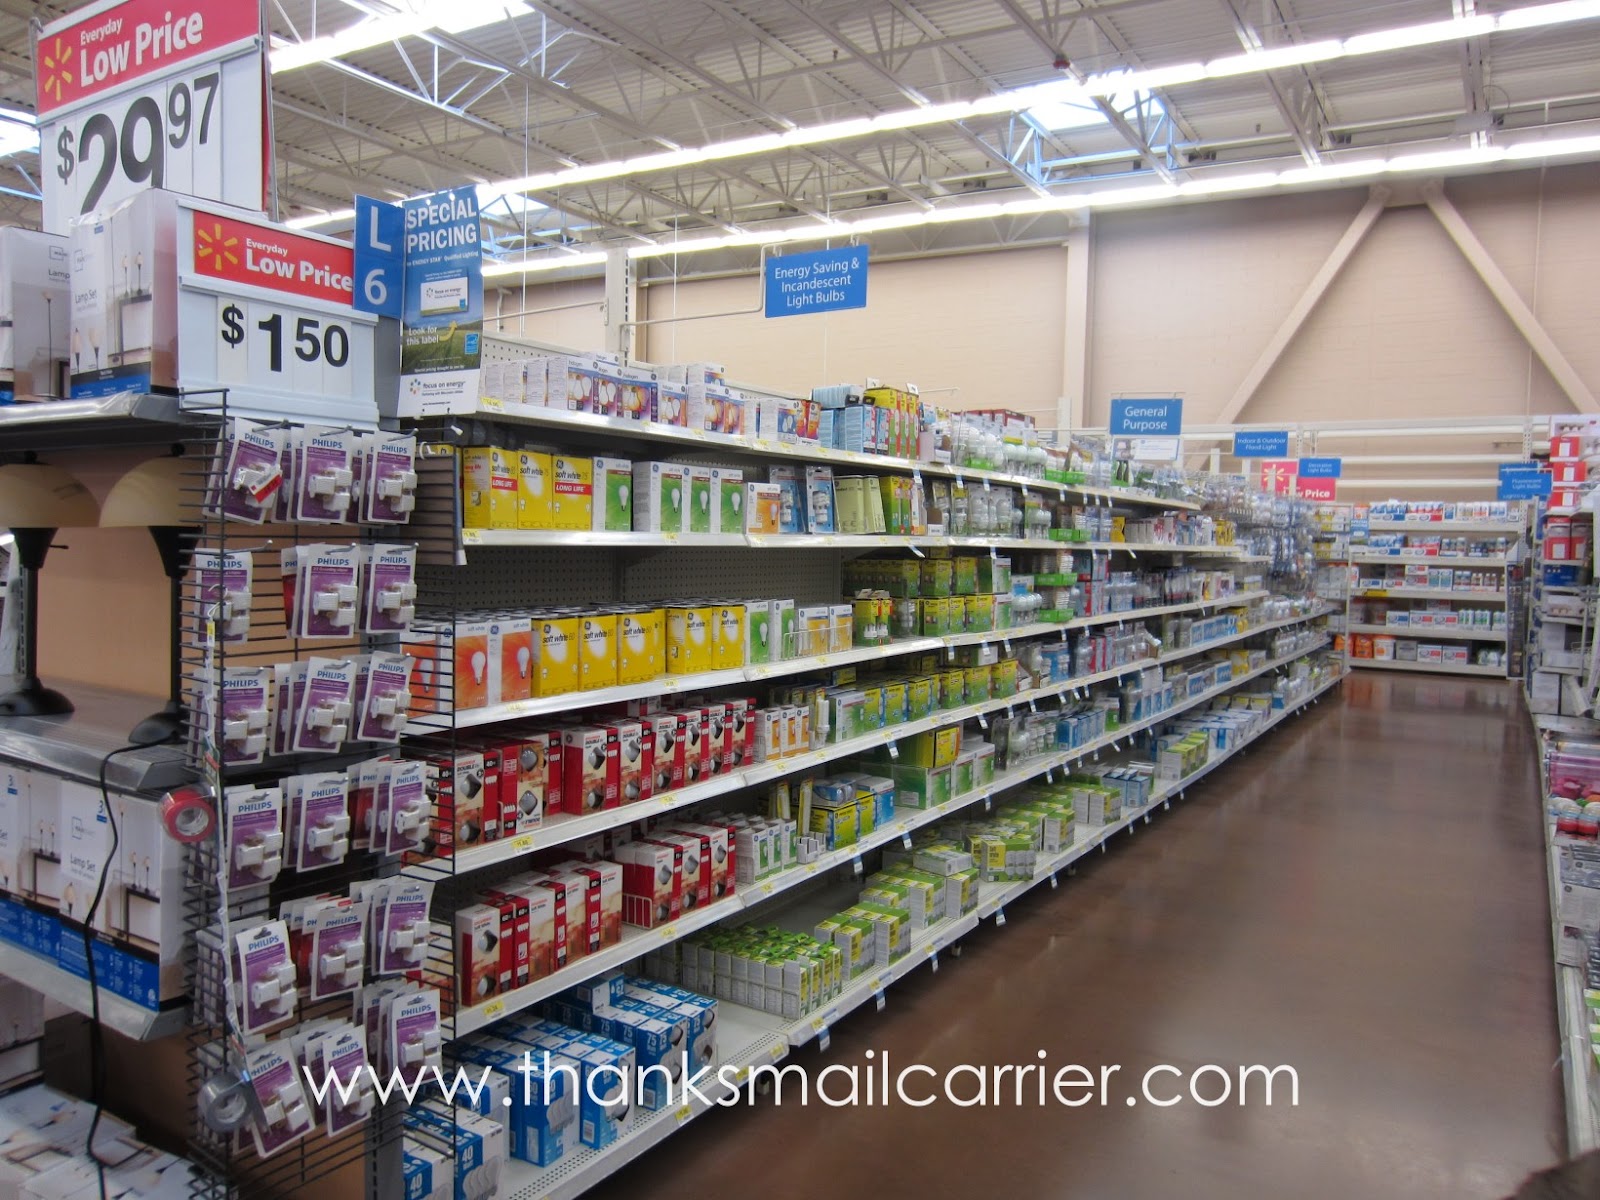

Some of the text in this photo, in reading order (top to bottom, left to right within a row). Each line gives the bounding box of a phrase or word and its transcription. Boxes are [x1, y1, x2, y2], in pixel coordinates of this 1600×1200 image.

[80, 18, 123, 46] Everyday
[80, 11, 203, 88] Low Price
[406, 197, 477, 229] SPECIAL
[370, 205, 392, 252] L
[406, 223, 477, 254] PRICING
[246, 237, 289, 258] Everyday
[246, 248, 353, 292] Low Price
[774, 257, 860, 279] Energy Saving &
[48, 269, 71, 280] Lamp
[364, 268, 388, 305] 6
[781, 274, 852, 293] Incandescent
[786, 290, 845, 309] Light Bulbs
[408, 326, 438, 336] Look for
[406, 334, 439, 346] this label
[1124, 405, 1167, 418] General
[1123, 419, 1168, 431] Purpose
[244, 433, 274, 449] PHILIPS
[312, 438, 342, 449] PHILIPS
[381, 444, 408, 454] PHILIPS
[492, 464, 510, 474] soft white
[520, 466, 531, 475] soft
[531, 467, 544, 476] white
[555, 470, 566, 480] soft
[567, 472, 581, 480] white
[492, 480, 504, 488] LONG
[556, 484, 572, 492] LONG
[1305, 489, 1331, 498] Price
[207, 560, 242, 568] PHLIPS
[317, 558, 350, 566] PHILIPS
[542, 636, 554, 644] soft
[554, 634, 568, 642] white
[378, 662, 404, 674] PHILIPS
[316, 670, 347, 680] PHILIPS
[224, 679, 259, 689] PHILIPS
[396, 774, 420, 785] PHILIPS
[311, 787, 340, 798] PHILIPS
[238, 802, 272, 813] PHILIPS
[396, 894, 424, 903] PHILIPS
[325, 914, 358, 928] PHILIPS
[248, 935, 280, 951] PHILIPS
[401, 1004, 432, 1017] PHILIPS
[647, 1032, 656, 1046] 75
[332, 1041, 360, 1058] PHILIPS
[462, 1145, 472, 1161] 40
[410, 1173, 422, 1188] 40
